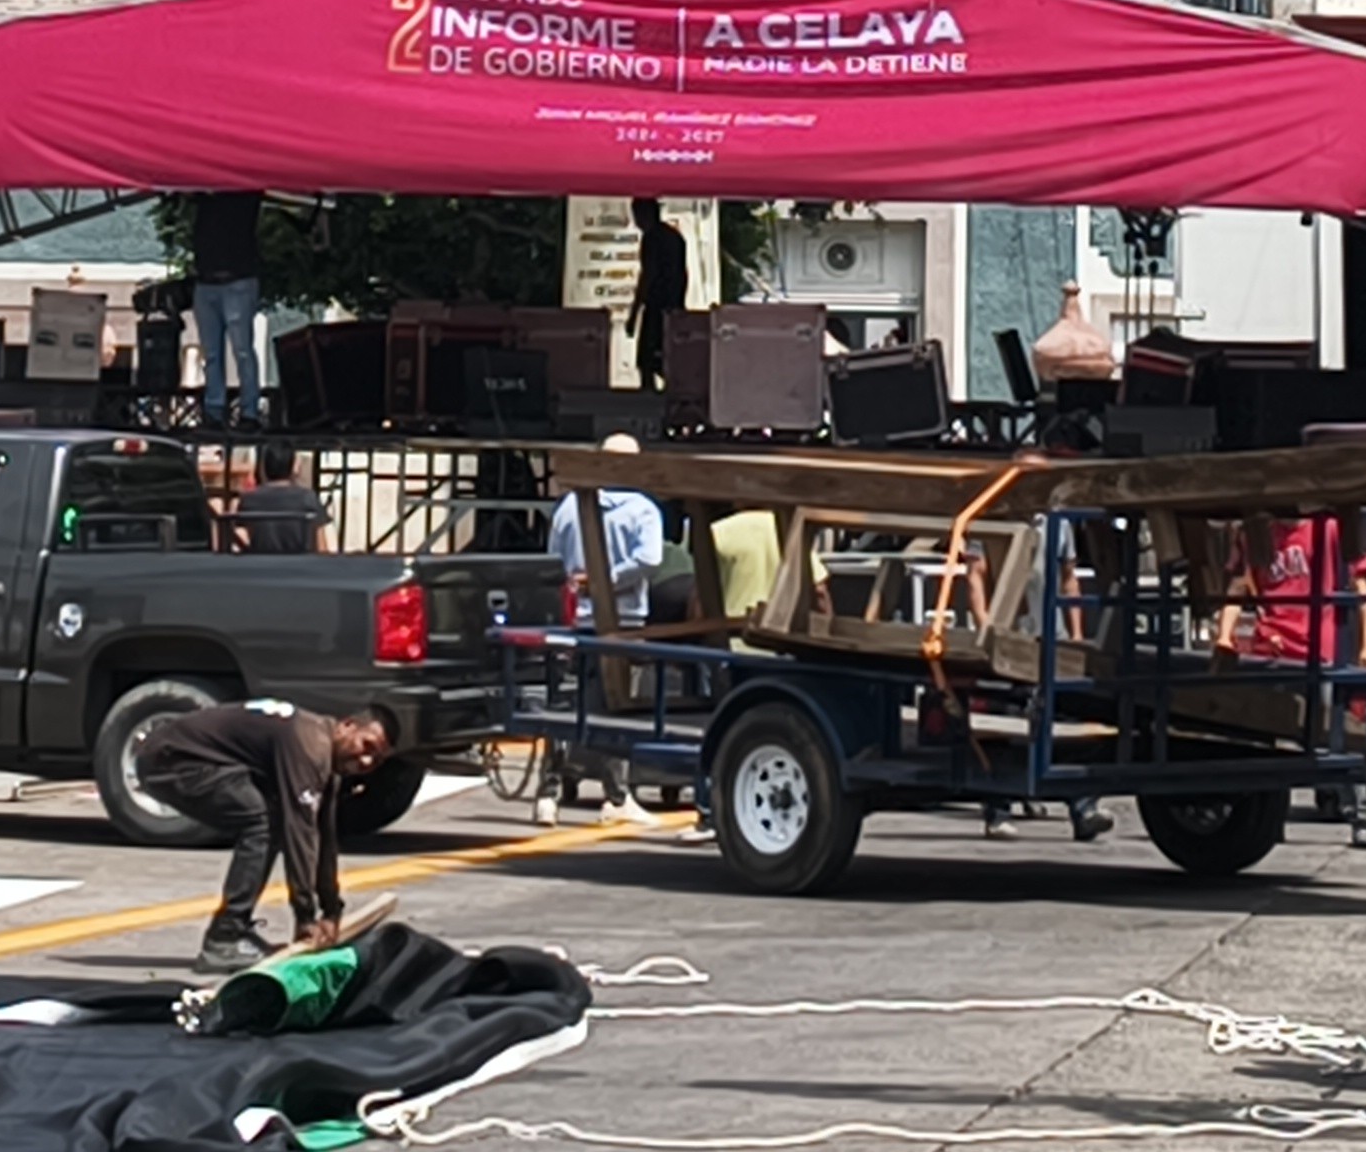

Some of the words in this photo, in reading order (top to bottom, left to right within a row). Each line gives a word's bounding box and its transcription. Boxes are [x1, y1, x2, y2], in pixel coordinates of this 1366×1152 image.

[431, 6, 636, 51] INFORME
[704, 14, 744, 48] A
[758, 10, 965, 48] CELAYA
[430, 45, 473, 74] DE
[484, 48, 662, 81] GOBIERNO
[704, 55, 795, 74] NADIE
[802, 55, 837, 75] LA
[845, 53, 969, 75] DETIENE
